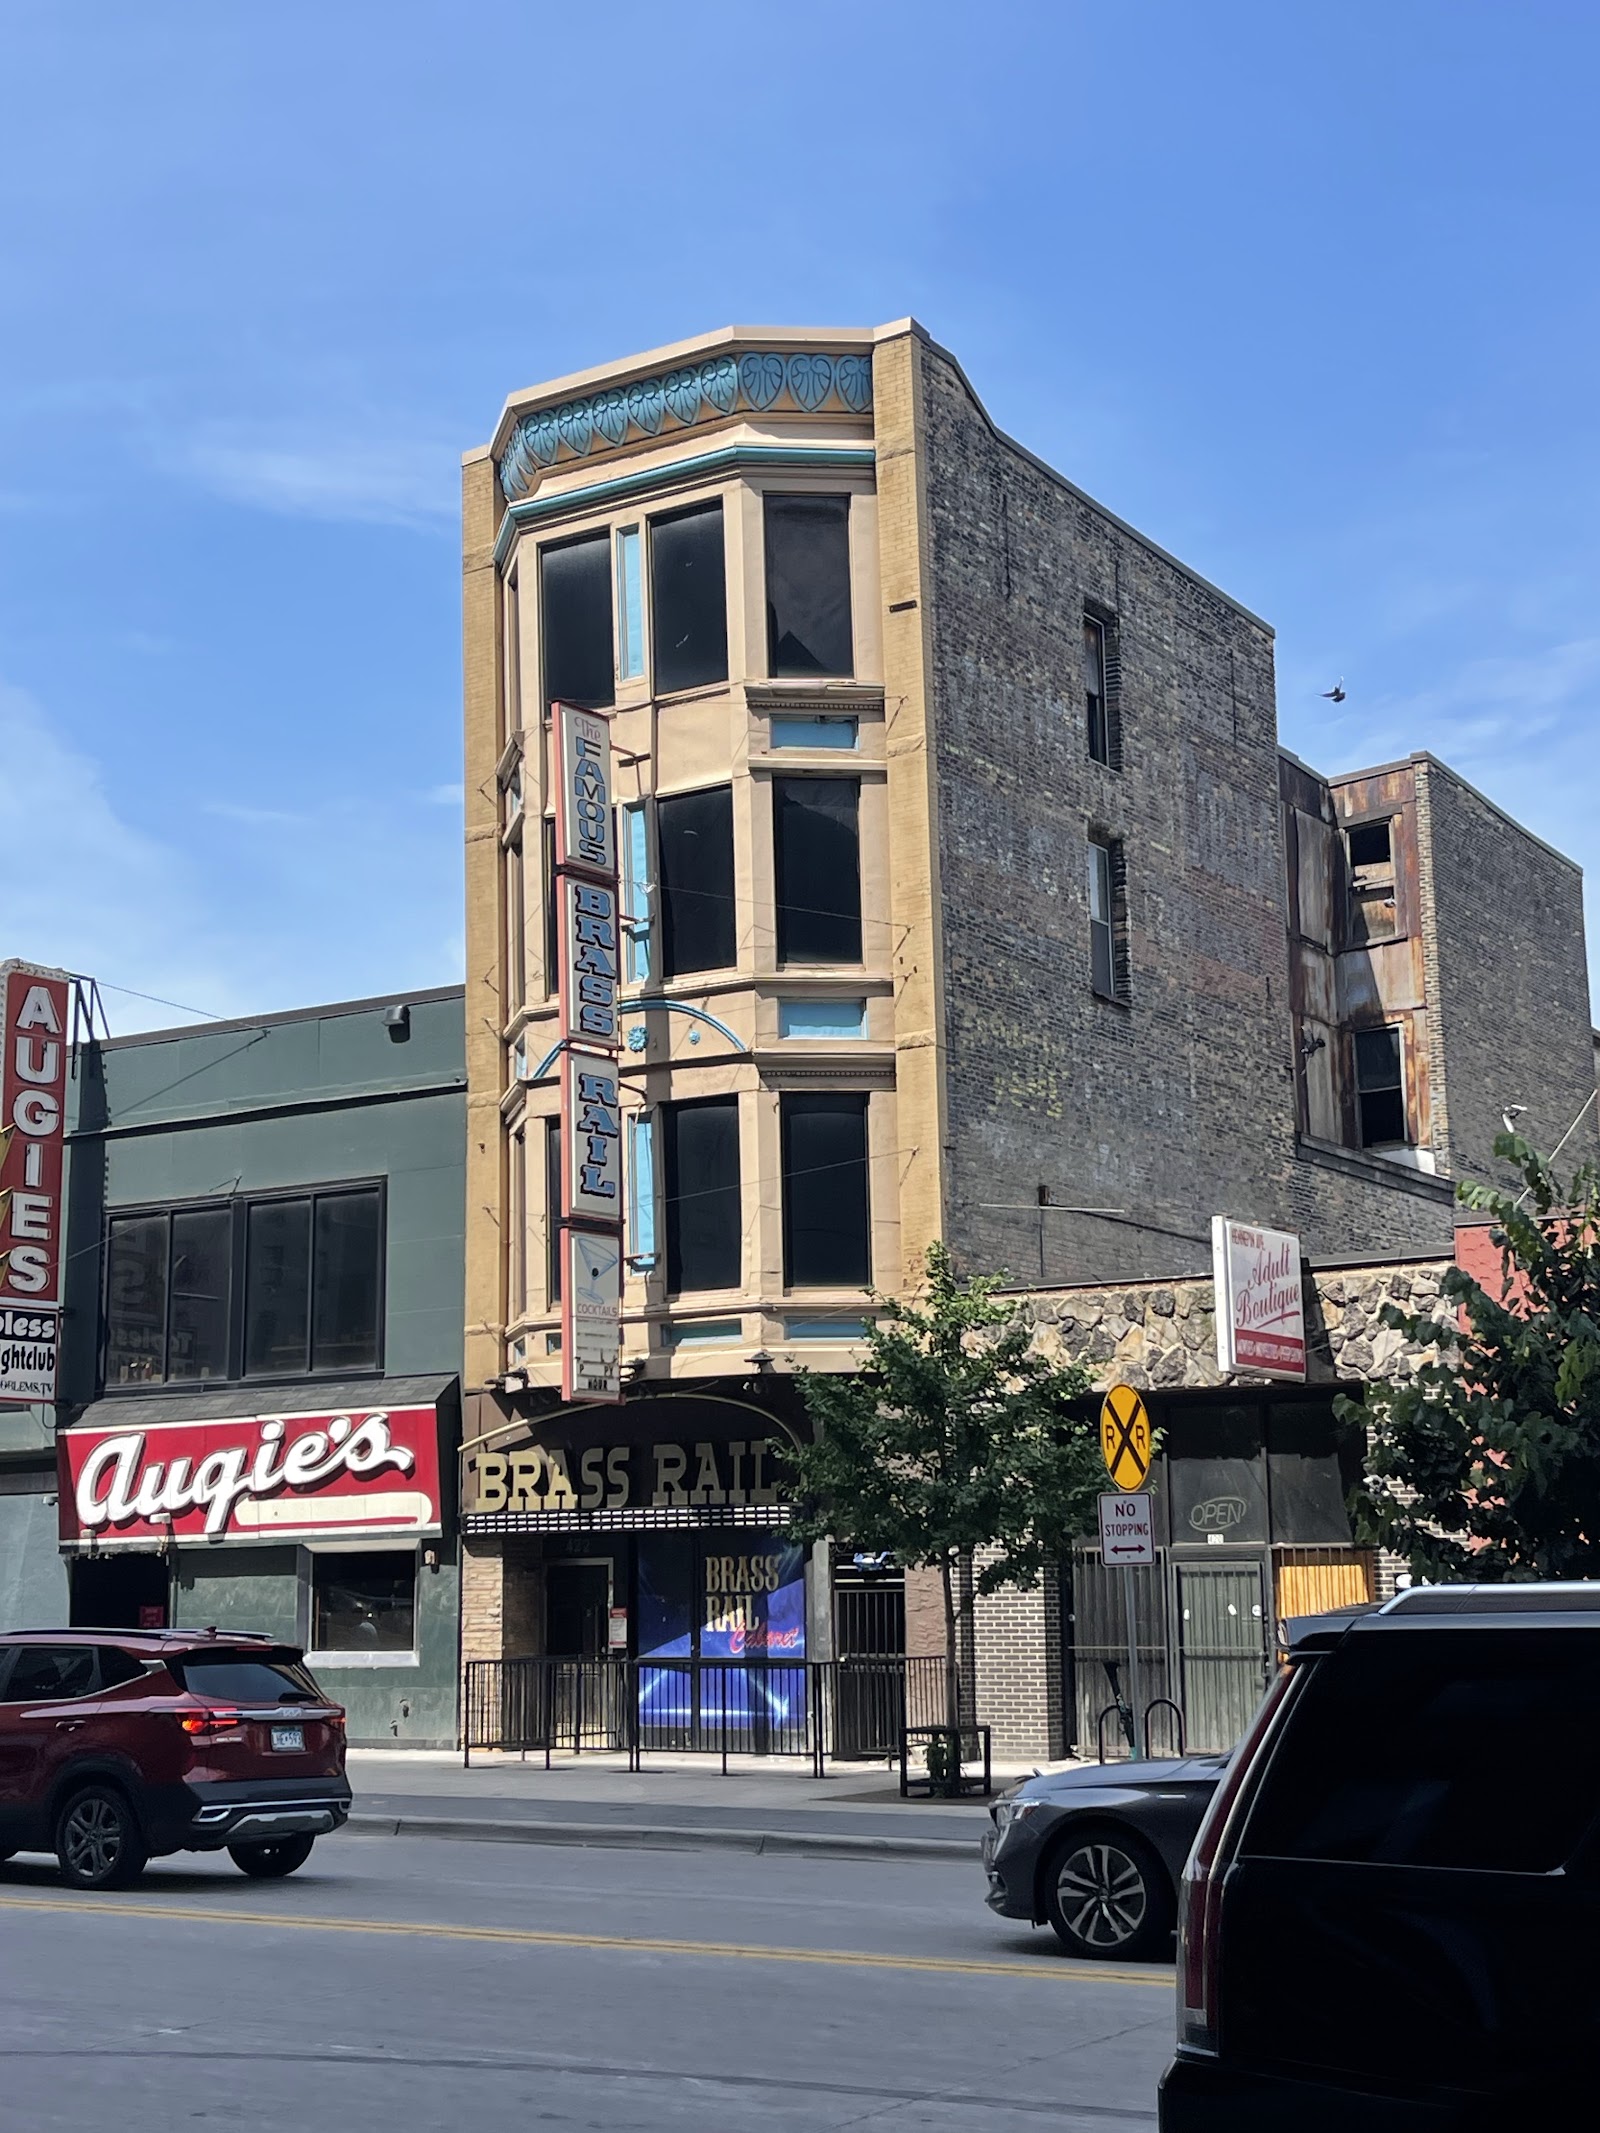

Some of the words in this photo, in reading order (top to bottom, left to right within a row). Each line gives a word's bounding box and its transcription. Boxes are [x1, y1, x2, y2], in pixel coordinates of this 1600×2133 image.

[574, 716, 601, 743] The
[574, 736, 606, 866] FAMOUS
[574, 885, 616, 1037] BRASS
[8, 985, 62, 1293] AUGIES
[577, 1073, 619, 1198] RAIL
[1248, 1242, 1291, 1290] Adult
[577, 1303, 618, 1317] COCKTAILS
[1236, 1281, 1300, 1327] Boutique
[1105, 1425, 1116, 1450] R
[1135, 1425, 1146, 1449] R
[76, 1412, 415, 1535] Augie's
[475, 1446, 630, 1512] BRASS
[652, 1441, 778, 1507] RAIL
[1115, 1503, 1136, 1517] NO
[1191, 1503, 1242, 1526] OPEN
[1105, 1522, 1149, 1537] STOPPING
[705, 1555, 780, 1592] BRASS
[705, 1594, 760, 1631] RAIL
[729, 1619, 800, 1654] Cabaret
